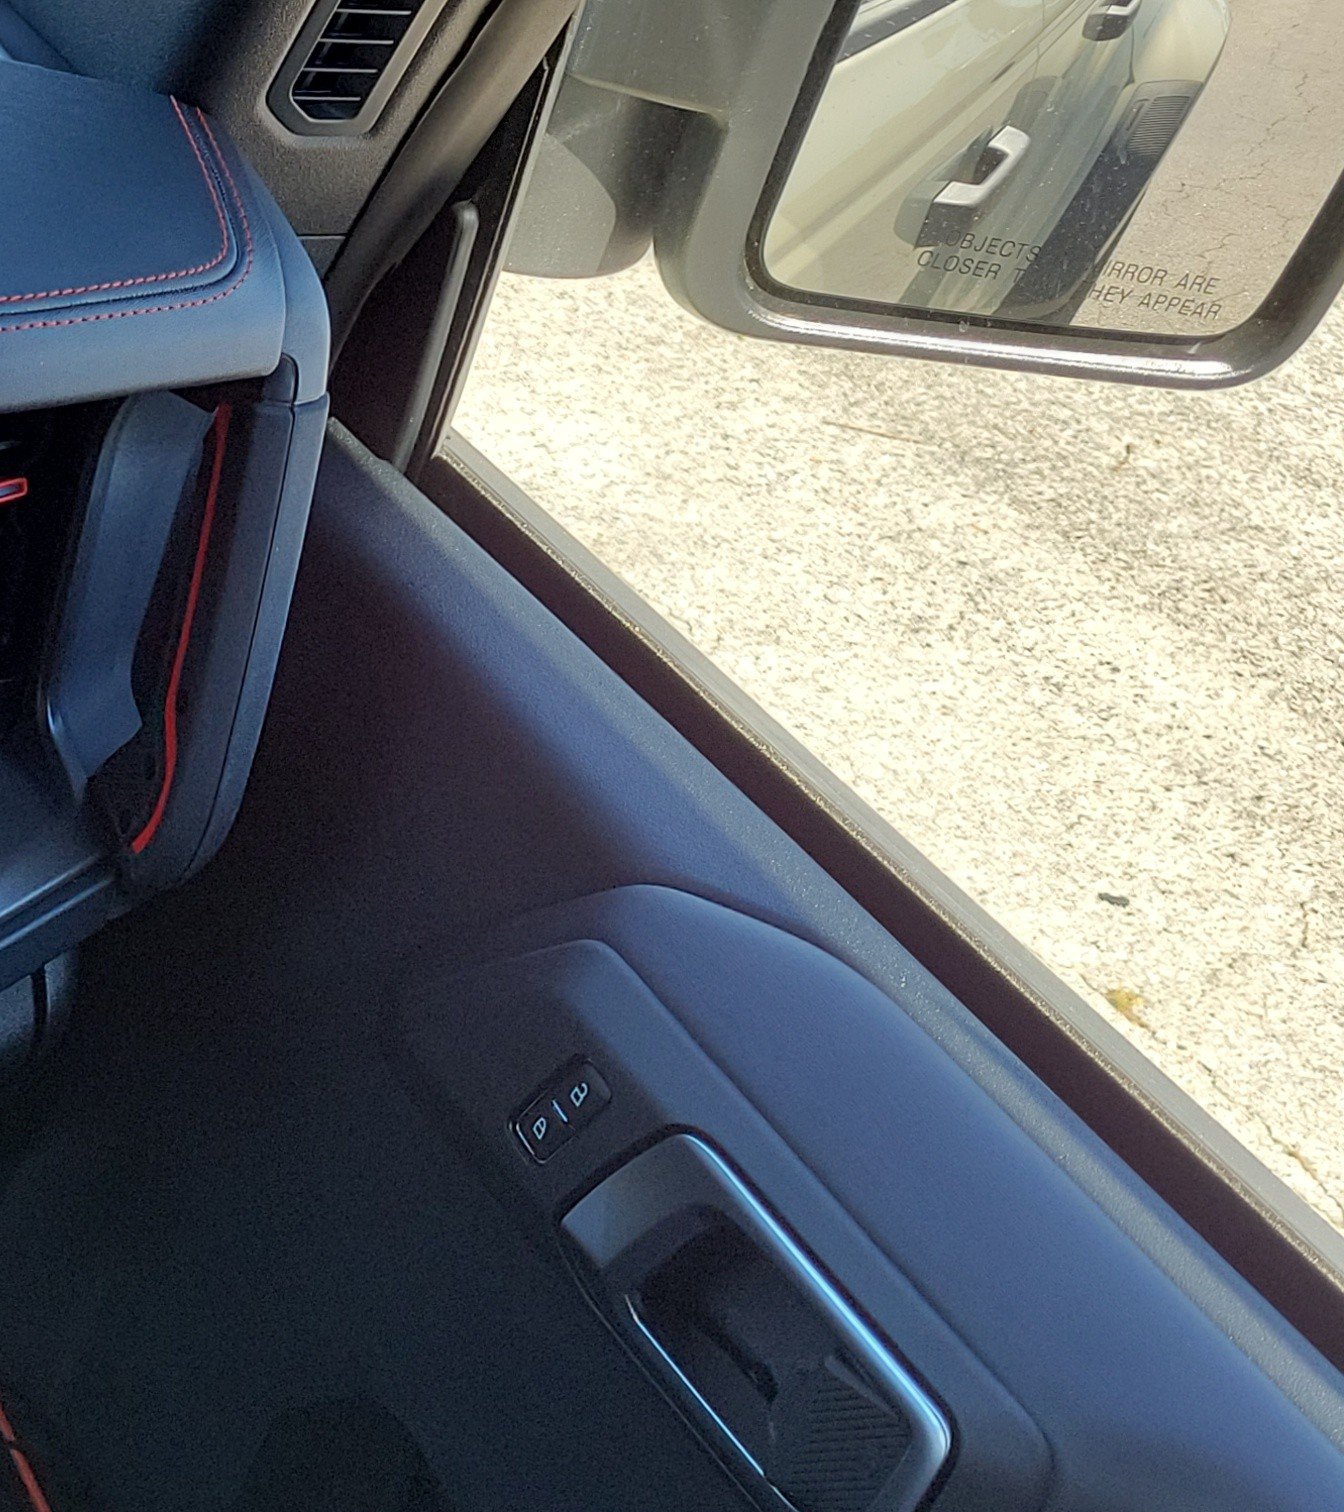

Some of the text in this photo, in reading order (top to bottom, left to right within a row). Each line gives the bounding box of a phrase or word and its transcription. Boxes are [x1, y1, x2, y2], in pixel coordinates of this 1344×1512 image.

[946, 230, 1041, 263] OBJECTS
[917, 250, 1002, 280] CLOSER
[1102, 261, 1220, 295] IRROR ARE
[1088, 282, 1222, 321] HEY APPEAR
